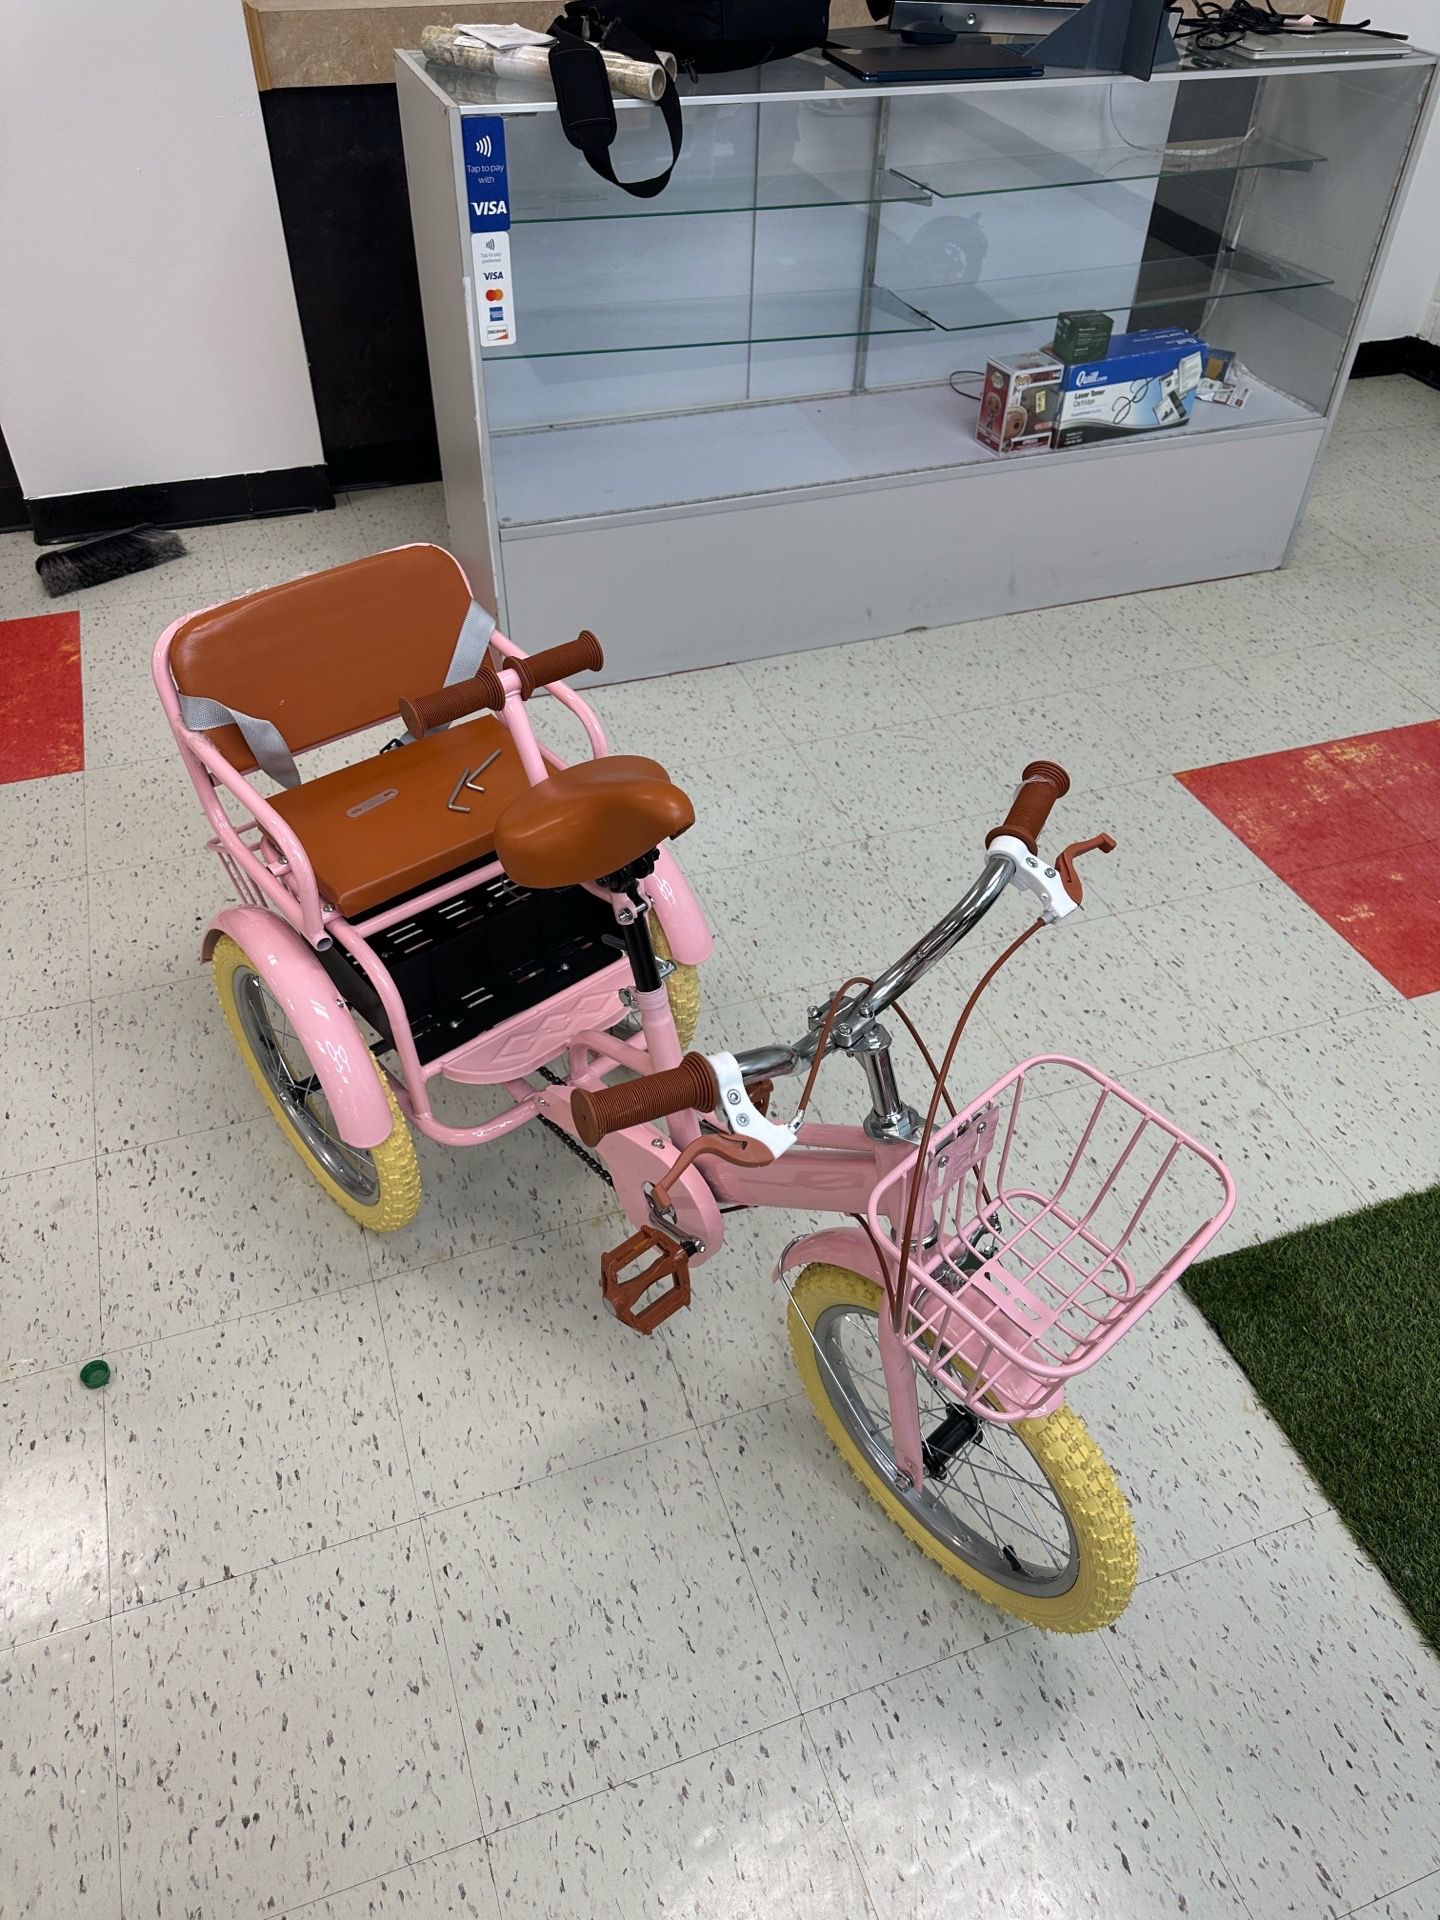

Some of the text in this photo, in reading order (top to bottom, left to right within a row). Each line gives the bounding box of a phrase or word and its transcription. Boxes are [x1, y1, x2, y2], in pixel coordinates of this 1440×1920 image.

[466, 165, 480, 174] Tap
[490, 164, 505, 173] pay
[478, 176, 495, 184] with
[470, 200, 508, 216] VISA
[483, 271, 504, 280] VISA
